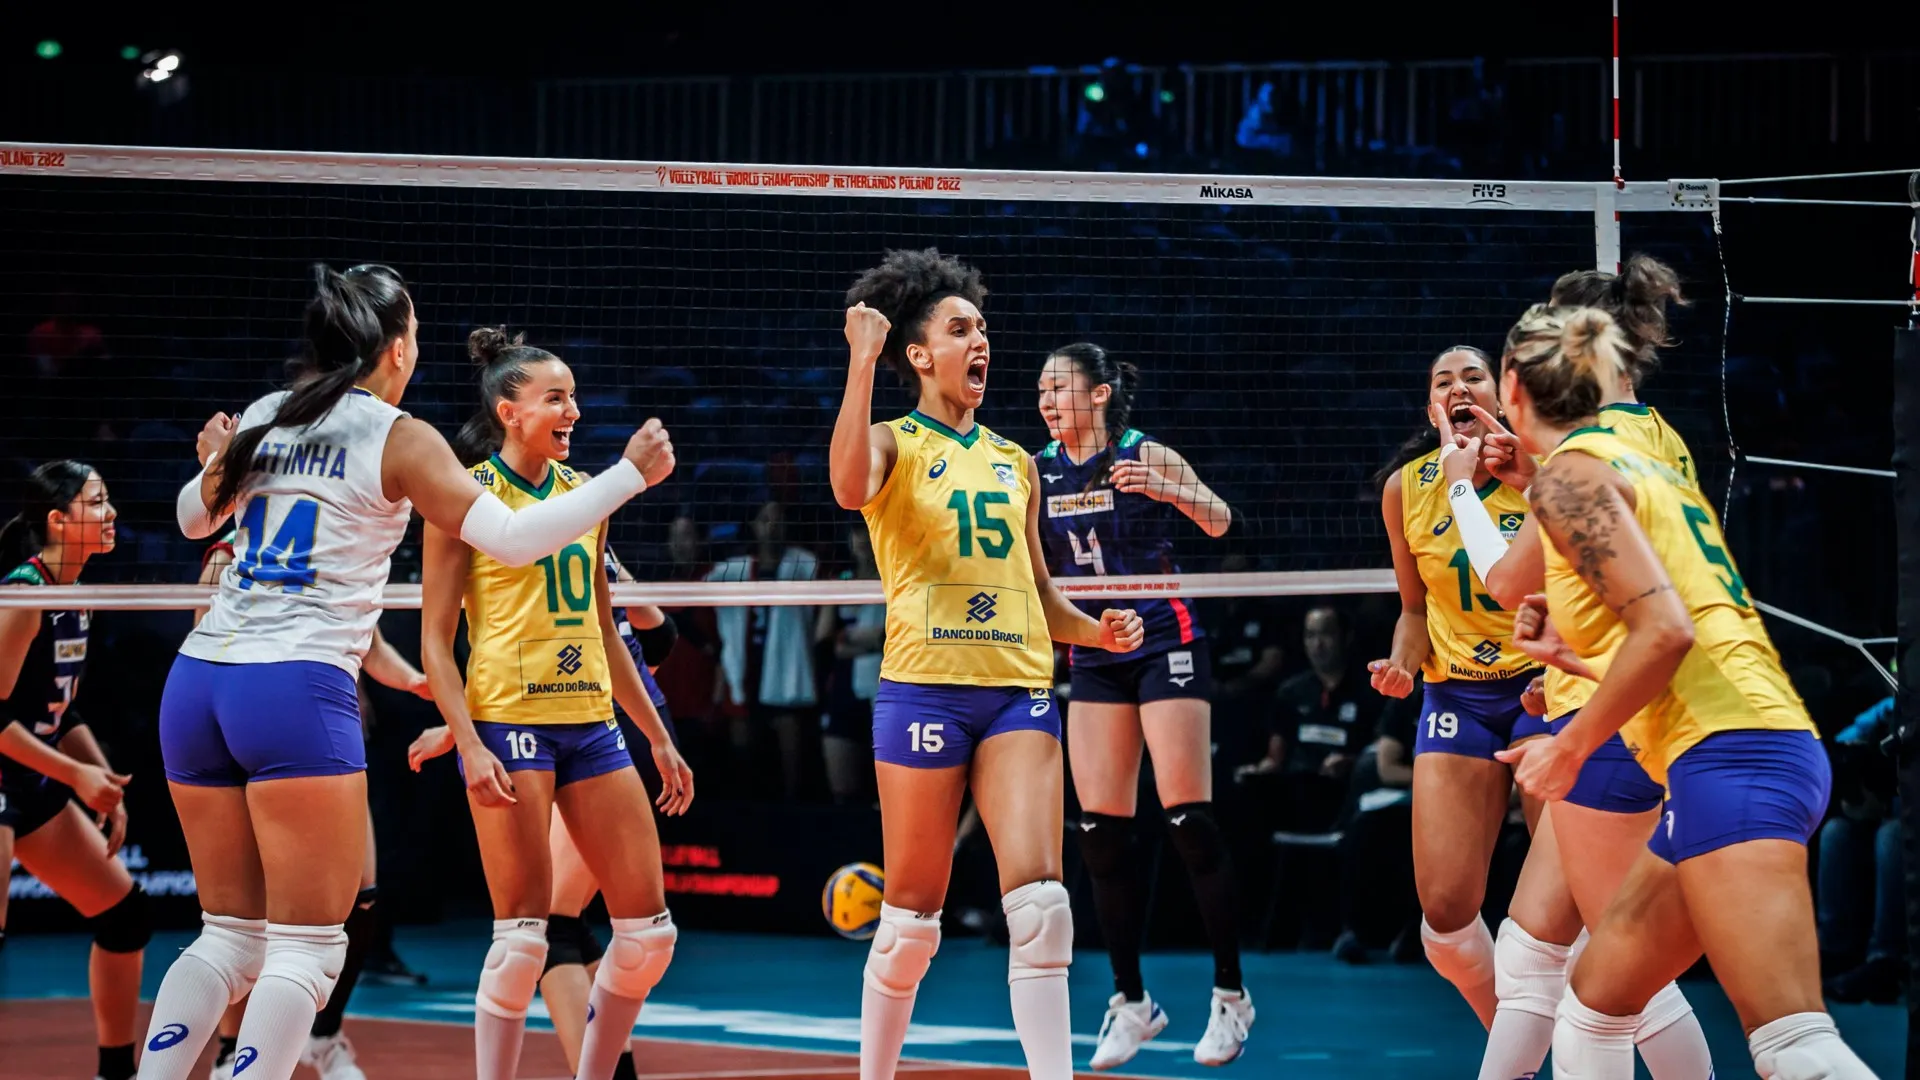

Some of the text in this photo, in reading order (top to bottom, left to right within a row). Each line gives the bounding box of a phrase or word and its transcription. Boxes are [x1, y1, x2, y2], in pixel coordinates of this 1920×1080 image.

[0, 150, 34, 166] OLAND
[669, 169, 722, 185] VOLLEYBALL
[725, 171, 759, 186] WORLD
[762, 172, 829, 188] CHAMPIONSHIP
[832, 175, 896, 190] NETHERLANDS
[899, 176, 934, 190] POLAND
[1200, 185, 1253, 199] MIKASA
[1472, 184, 1506, 198] FIVB
[251, 442, 347, 480] ATINHA
[1051, 494, 1105, 513] CAPCOM
[947, 489, 1015, 559] 15
[237, 494, 319, 594] 14
[1067, 526, 1106, 576] 4
[1681, 503, 1749, 608] 5
[535, 543, 591, 613] 10
[1449, 548, 1504, 612] 1
[932, 627, 1025, 645] BANCO DO BRASIL
[1451, 663, 1483, 680] BANCO
[1484, 671, 1498, 680] DO
[528, 682, 564, 694] BANCO
[565, 682, 577, 692] DO
[907, 722, 945, 753] 15
[1426, 712, 1458, 739] 19
[506, 731, 537, 759] 10
